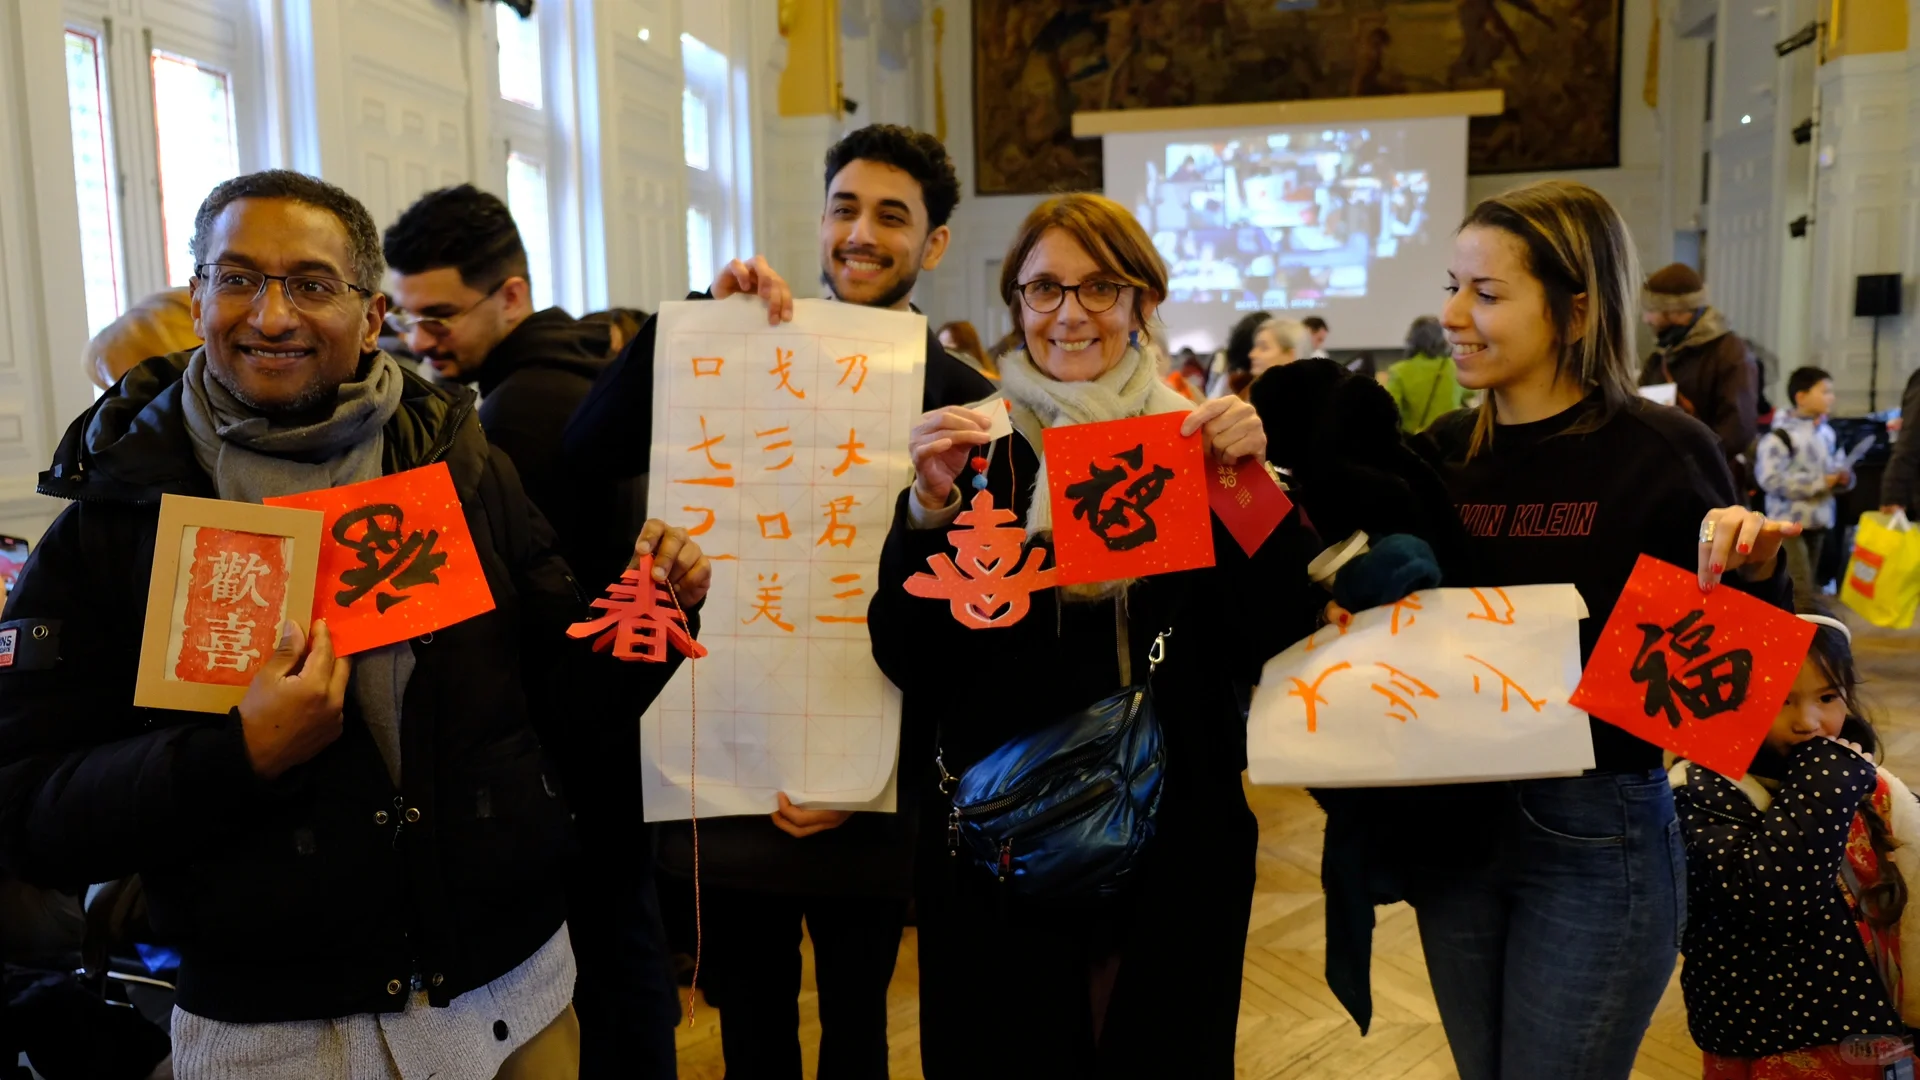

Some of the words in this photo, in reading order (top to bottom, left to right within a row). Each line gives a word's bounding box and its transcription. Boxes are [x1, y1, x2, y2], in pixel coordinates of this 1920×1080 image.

[690, 356, 726, 378] 口
[835, 353, 869, 395] 乃
[831, 427, 873, 478] 大
[755, 511, 794, 541] 口
[815, 494, 862, 549] 君
[1508, 501, 1599, 537] KLEIN
[197, 551, 272, 672] 歡喜
[565, 552, 709, 664] 春
[740, 572, 797, 634] 美
[814, 573, 868, 625] 三
[1629, 609, 1753, 729] 福
